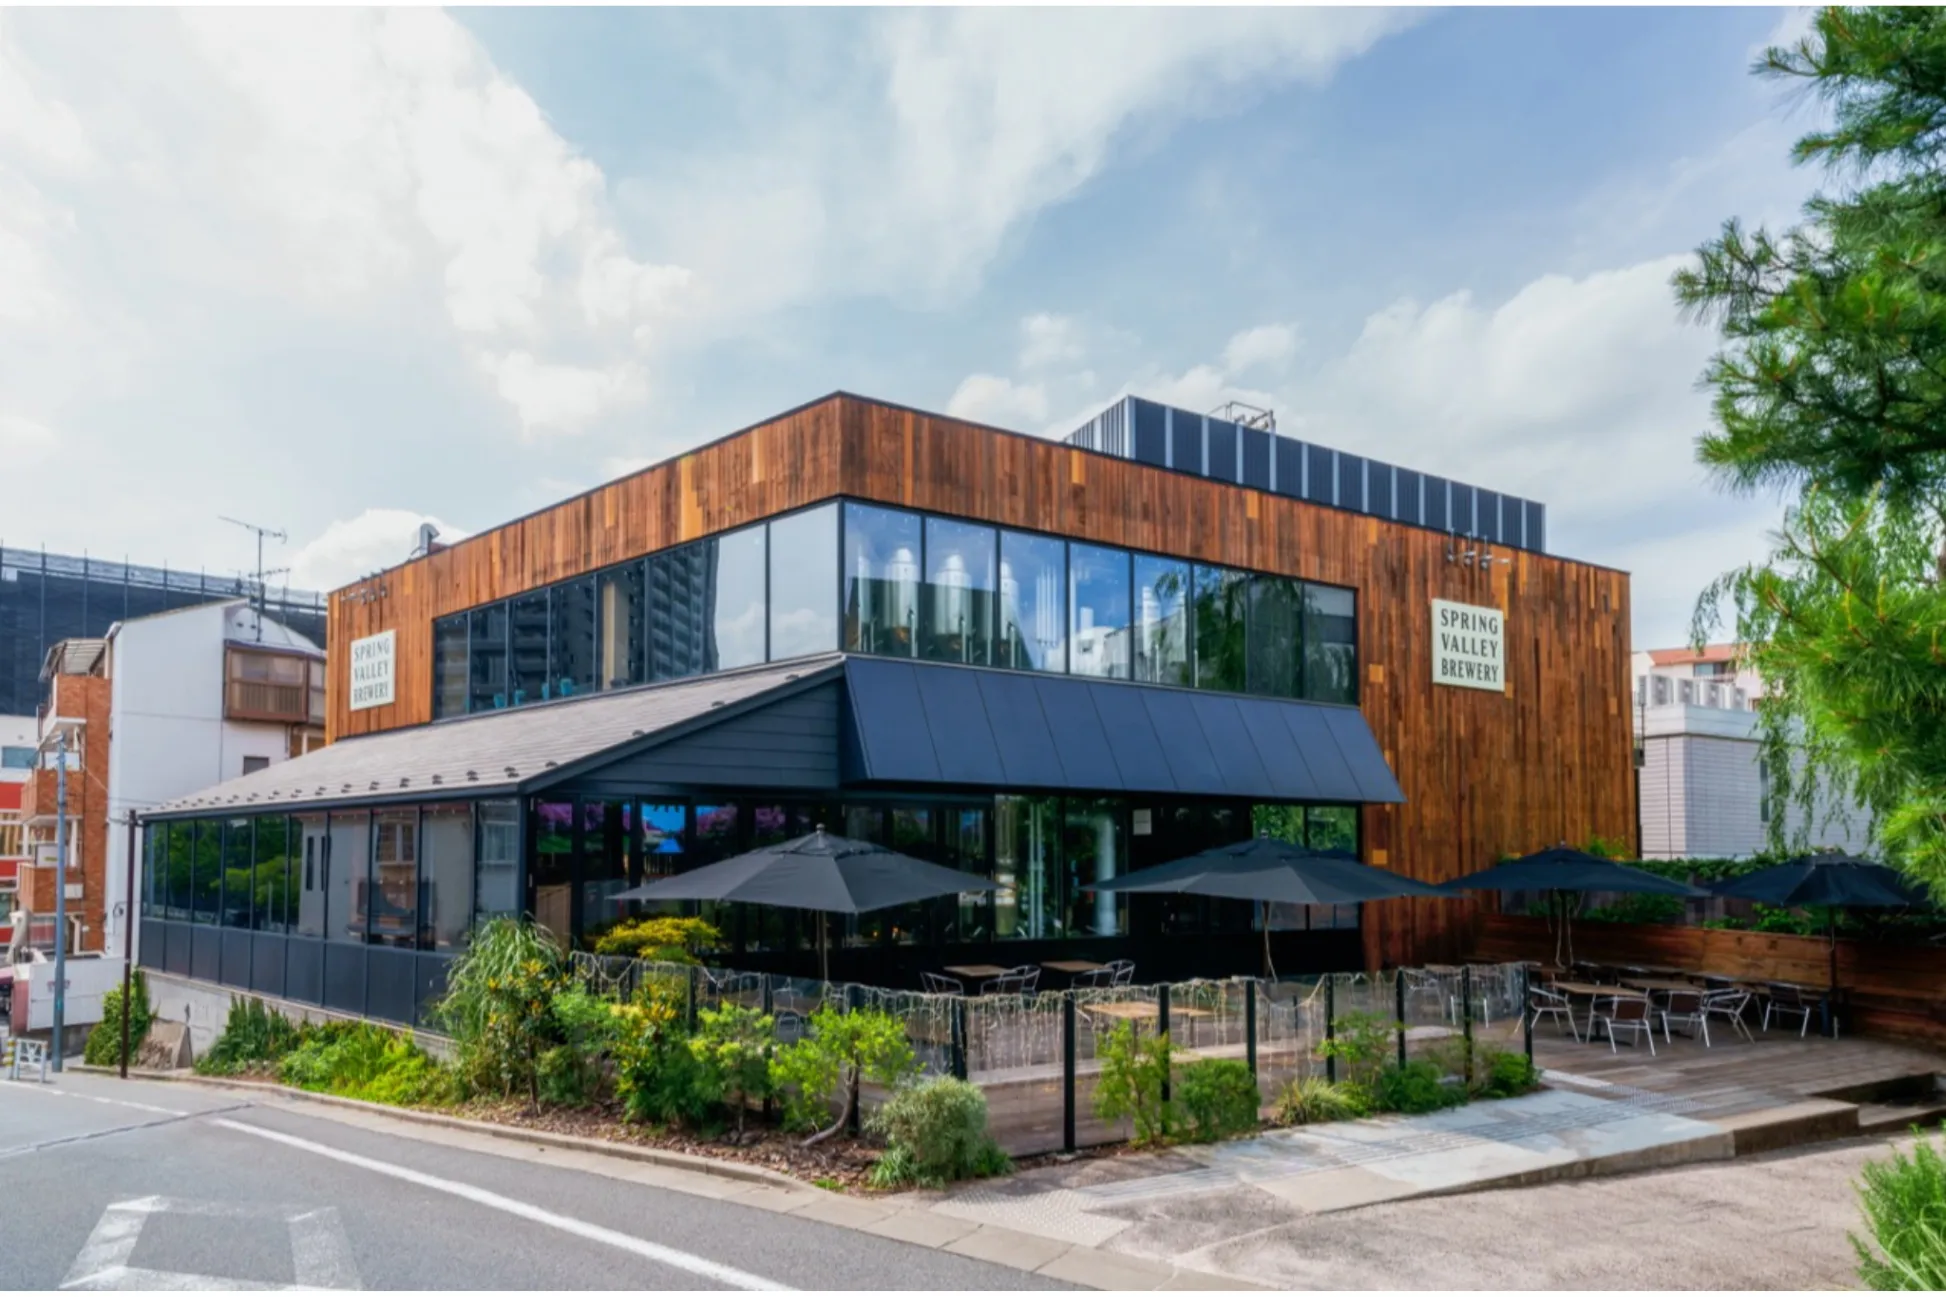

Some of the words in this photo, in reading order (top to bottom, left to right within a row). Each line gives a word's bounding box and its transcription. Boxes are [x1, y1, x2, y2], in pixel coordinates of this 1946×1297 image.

[1441, 608, 1498, 635] SPRING
[354, 638, 390, 661] SPRING
[1441, 632, 1498, 658] VALLEY
[354, 661, 388, 682] VALLEY
[1441, 658, 1499, 682] BREWERY
[353, 682, 388, 704] BREWERY
